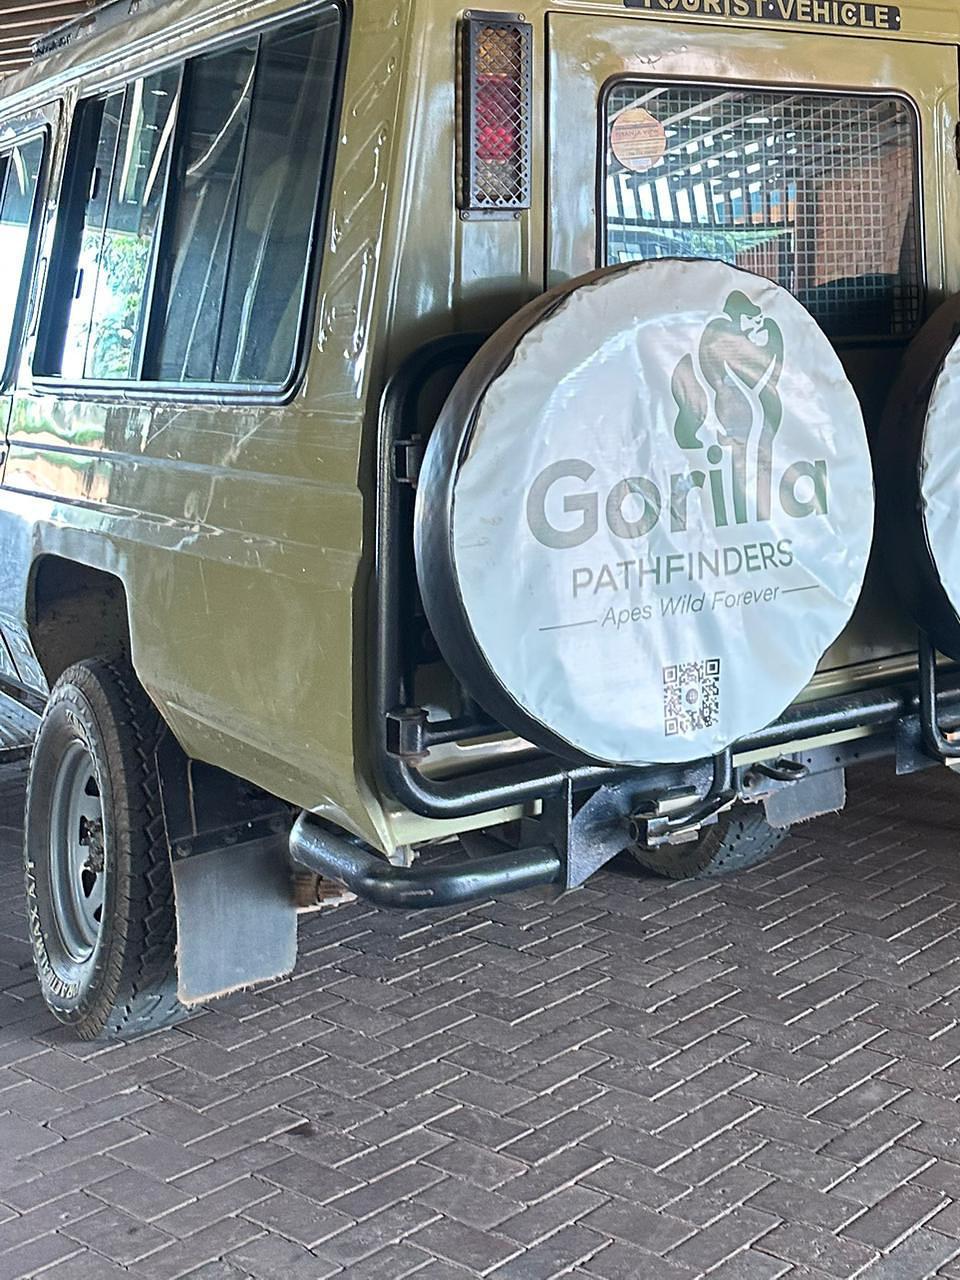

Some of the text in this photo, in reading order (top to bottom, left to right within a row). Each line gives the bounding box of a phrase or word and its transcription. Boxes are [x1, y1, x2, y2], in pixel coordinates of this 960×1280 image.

[526, 438, 829, 550] Gorilla
[571, 538, 794, 599] PATHFINDERS
[601, 586, 781, 630] Apes Wild Forever
